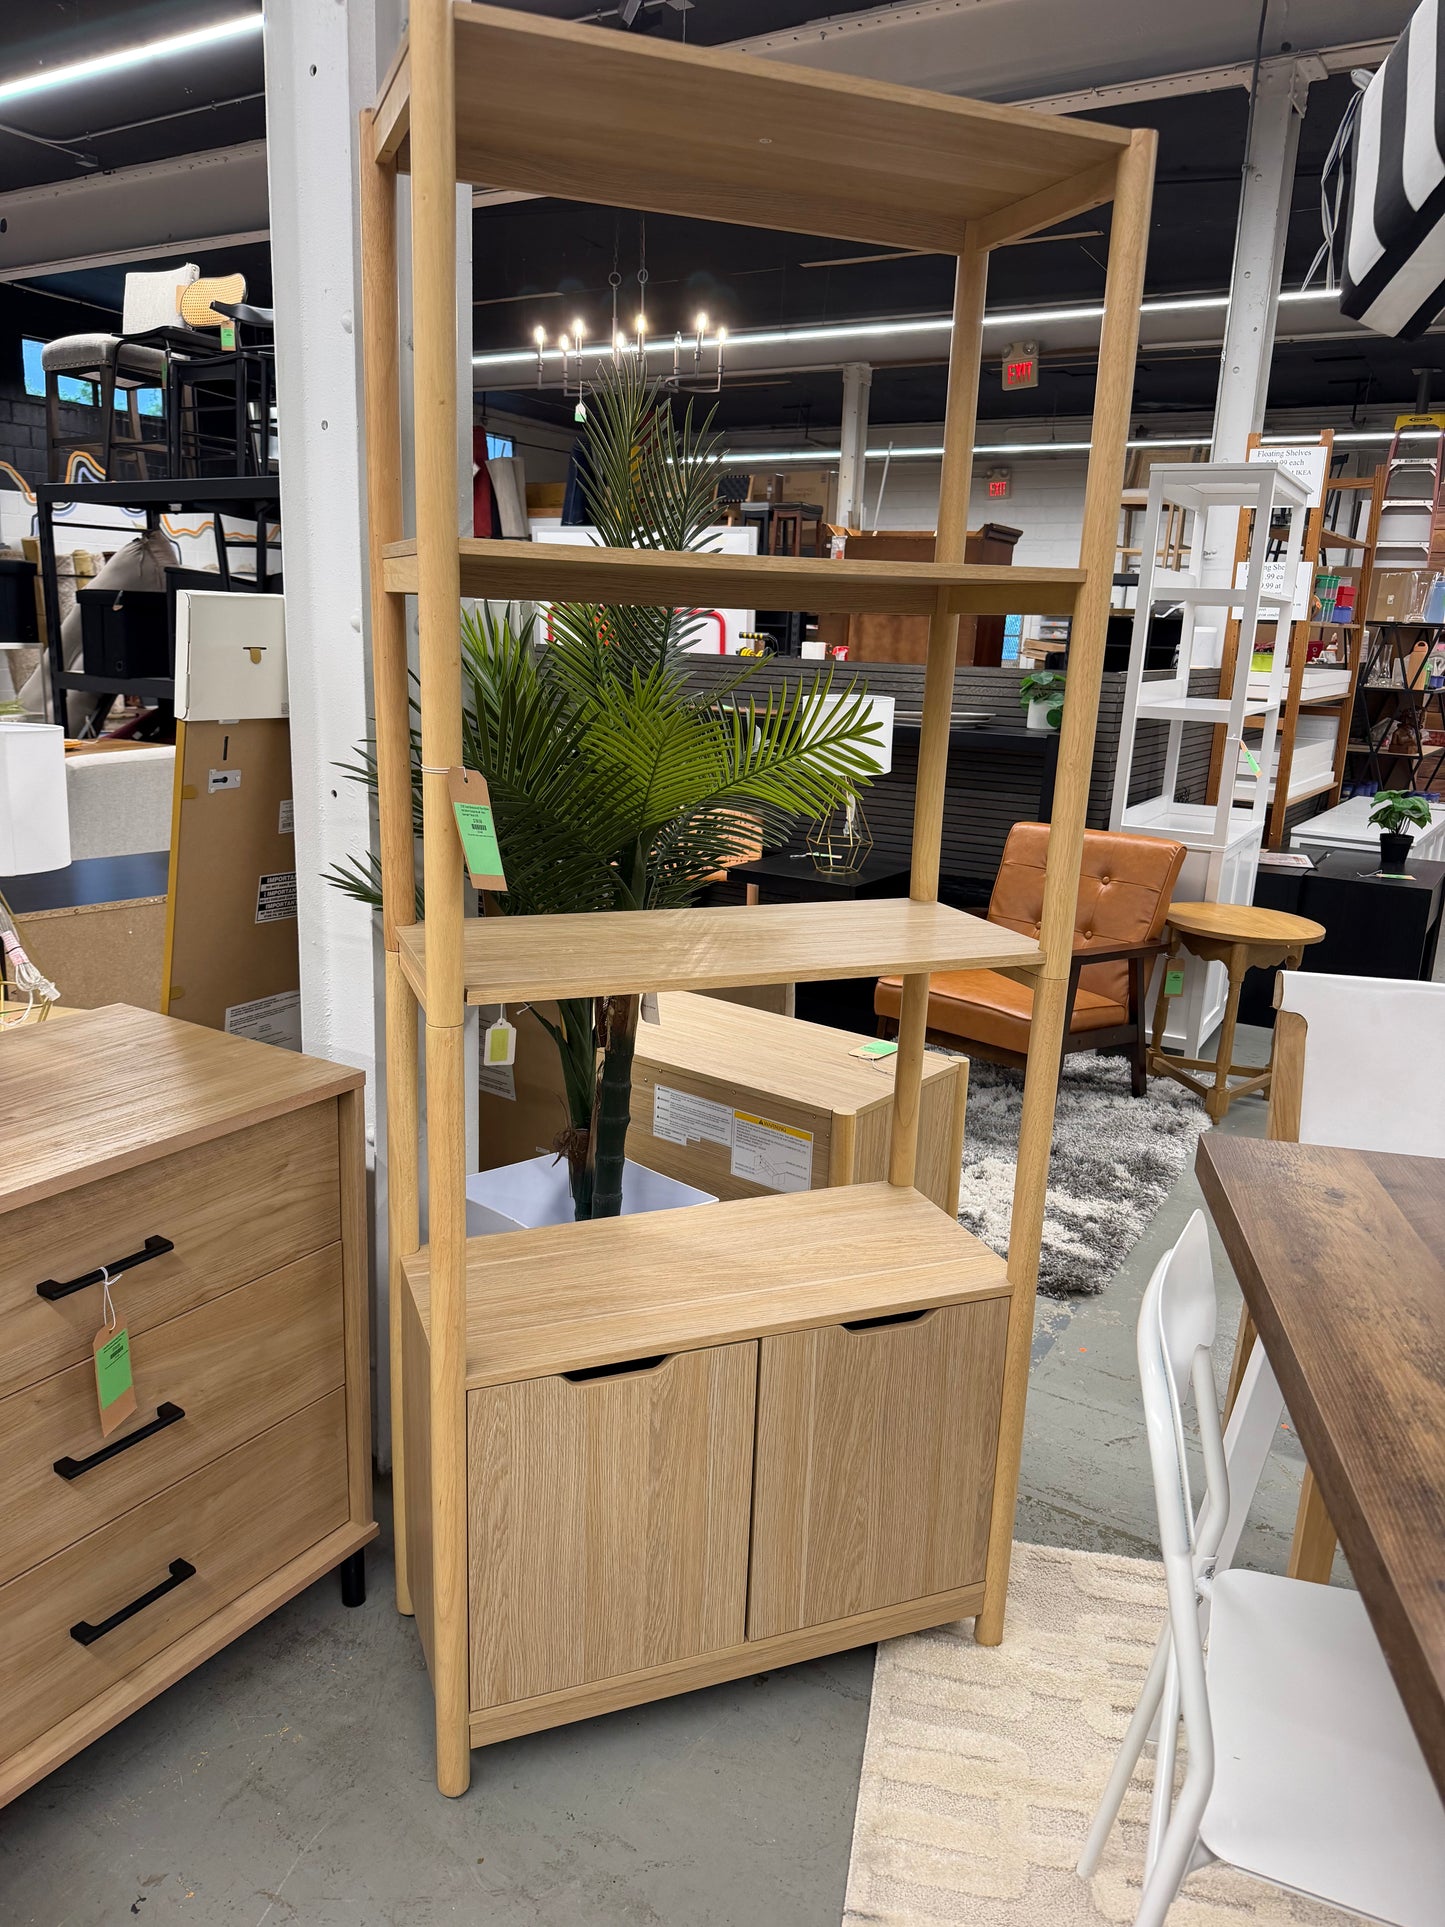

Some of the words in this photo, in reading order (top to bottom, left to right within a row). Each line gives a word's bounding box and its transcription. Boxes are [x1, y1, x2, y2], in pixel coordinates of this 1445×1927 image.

[1007, 361, 1033, 385] EXIT
[1257, 450, 1284, 458] Floating
[989, 482, 1007, 497] EXIT
[267, 874, 296, 883] IMPORTA
[266, 888, 296, 897] IMPORTAN
[763, 1121, 787, 1132] WARNING
